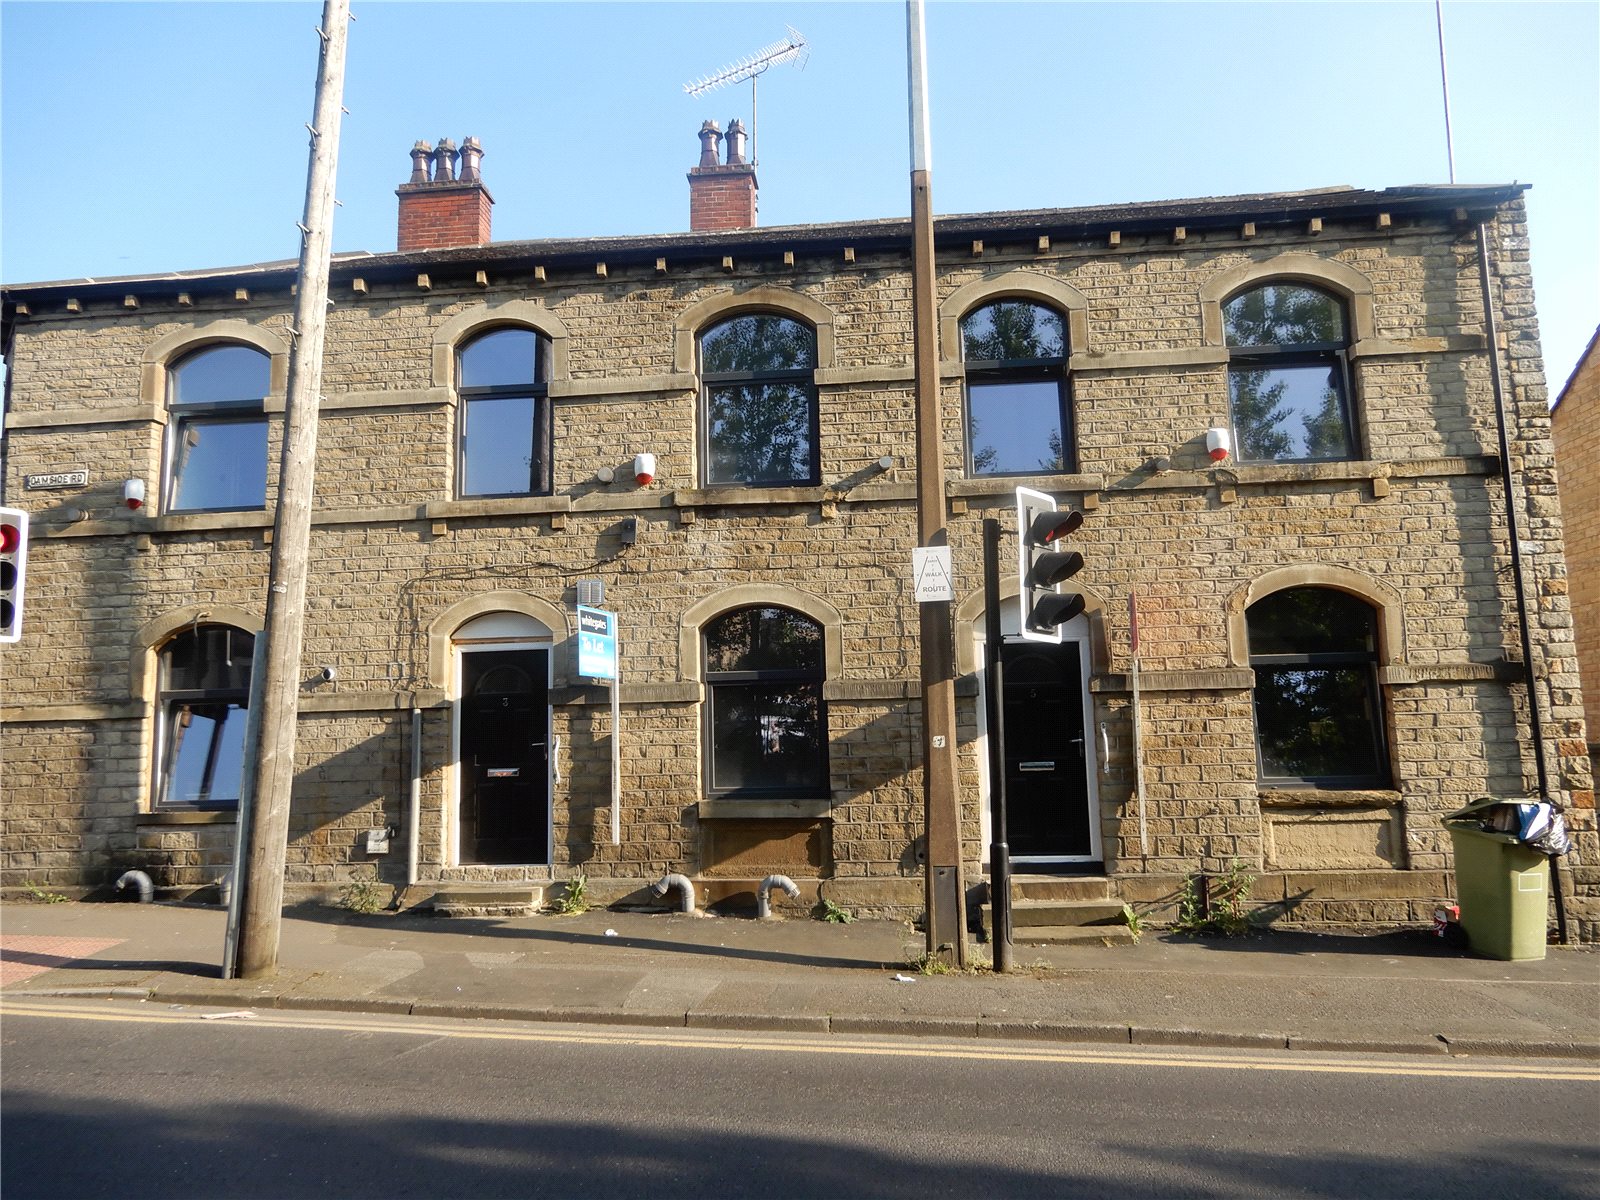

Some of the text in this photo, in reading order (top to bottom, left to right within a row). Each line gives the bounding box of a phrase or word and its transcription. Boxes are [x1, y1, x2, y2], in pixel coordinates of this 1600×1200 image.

[71, 474, 83, 483] RD
[582, 636, 605, 654] To Let
[502, 697, 509, 707] 3
